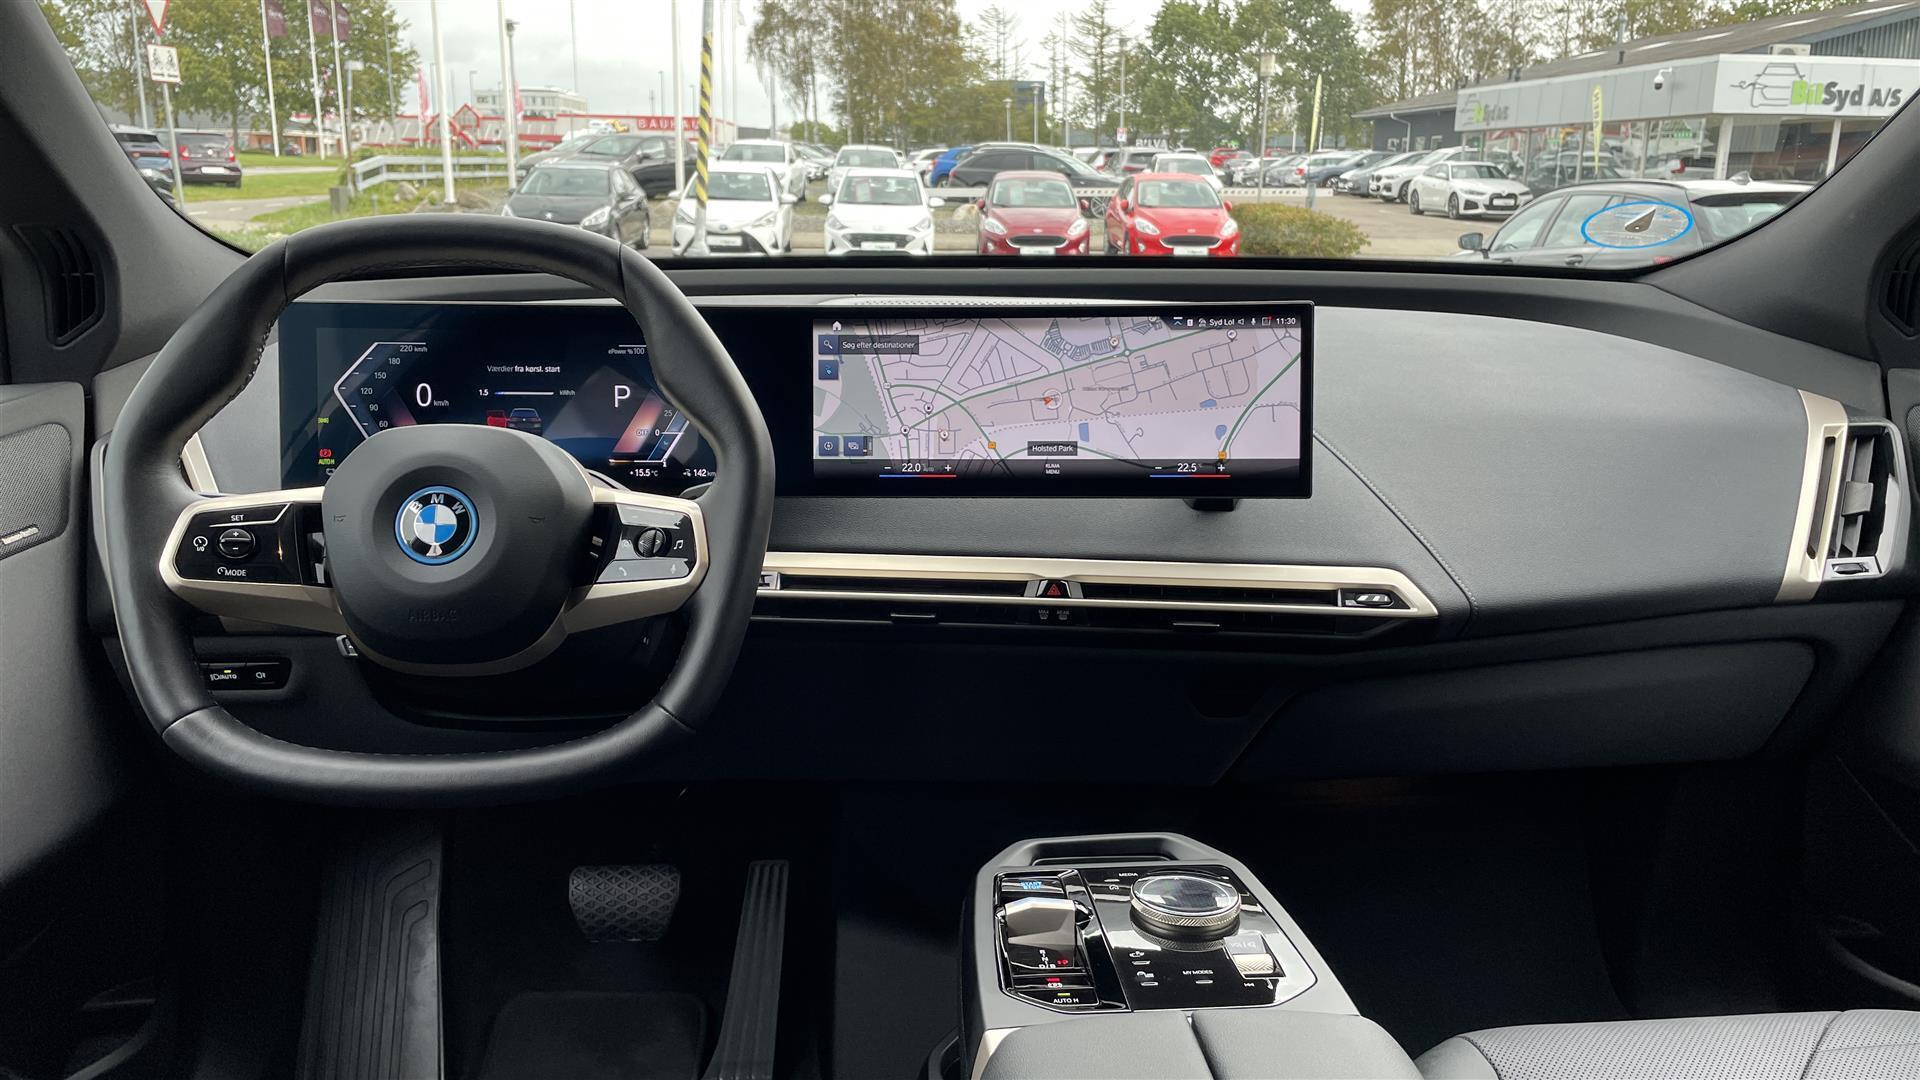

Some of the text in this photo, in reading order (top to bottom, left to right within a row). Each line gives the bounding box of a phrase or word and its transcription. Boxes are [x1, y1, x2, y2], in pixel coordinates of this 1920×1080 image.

[1791, 80, 1902, 111] BilSyd A/S
[1276, 317, 1296, 325] 11:30
[873, 341, 915, 349] destinationer
[388, 357, 401, 365] 180
[514, 365, 525, 373] fra
[544, 365, 561, 373] start
[374, 371, 387, 379] 150
[361, 387, 373, 395] 120
[416, 382, 450, 407] 0 km/h
[479, 388, 489, 396] 1.5
[614, 384, 631, 408] P
[369, 403, 379, 411] 90
[664, 409, 673, 417] 25
[379, 420, 388, 428] 60
[901, 463, 922, 473] 22.0
[1177, 462, 1198, 473] 22.5
[693, 468, 707, 477] 142
[409, 493, 466, 515] BMW
[230, 514, 244, 522] SET
